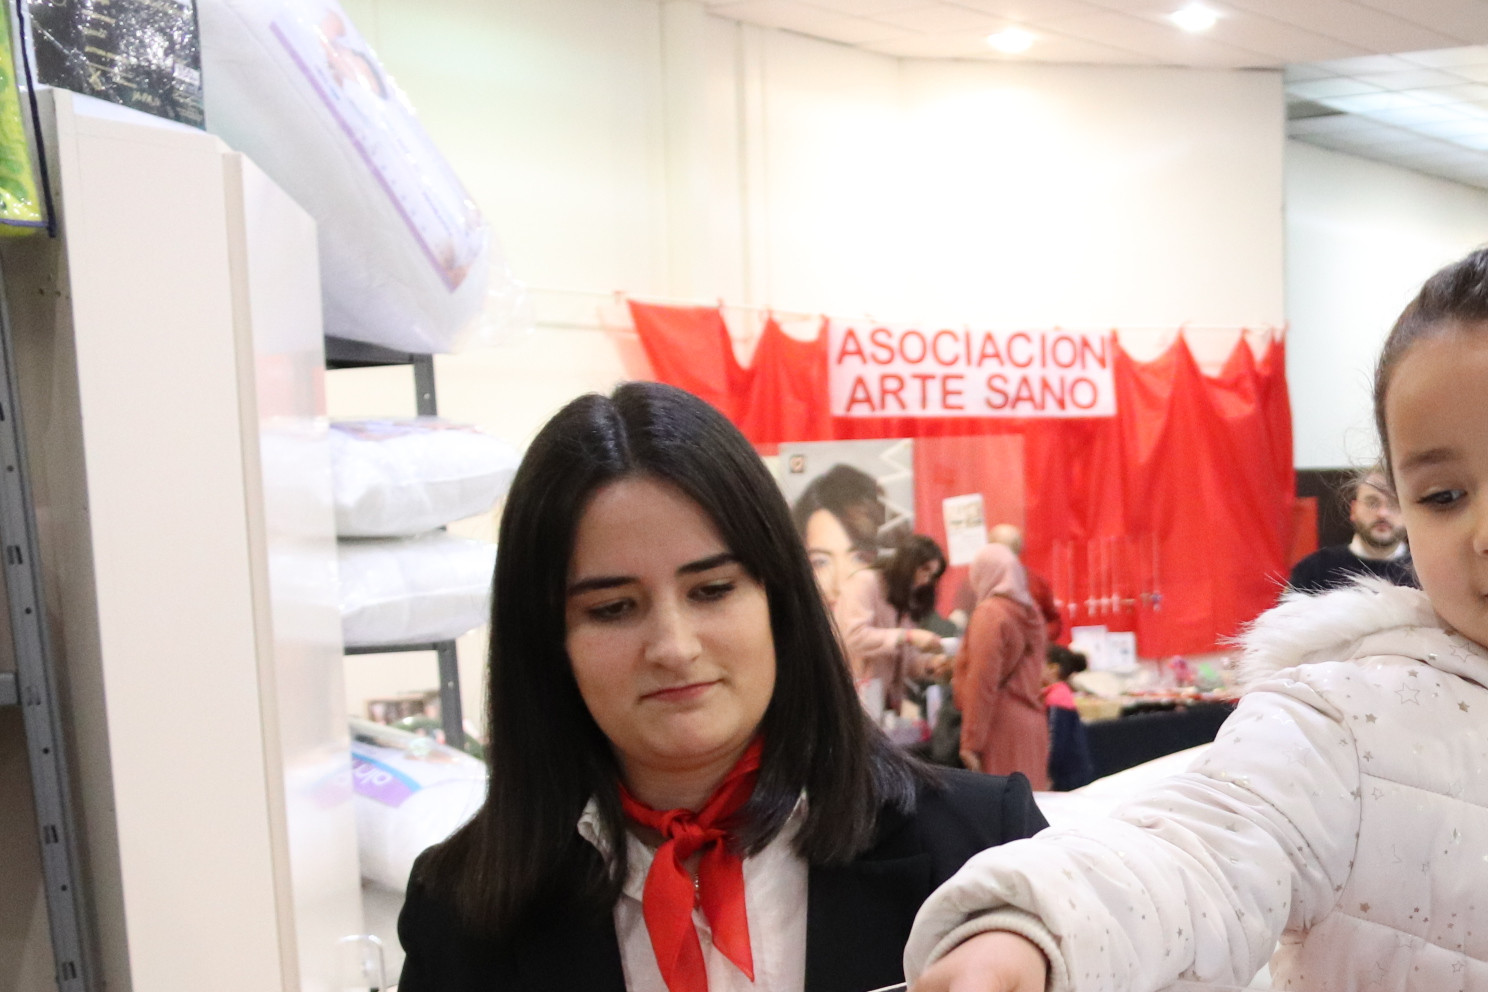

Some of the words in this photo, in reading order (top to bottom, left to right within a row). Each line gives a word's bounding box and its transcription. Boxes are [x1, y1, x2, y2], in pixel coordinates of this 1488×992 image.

[837, 327, 1108, 370] ASOCIACION
[845, 373, 966, 413] ARTE
[985, 374, 1099, 410] SANO
